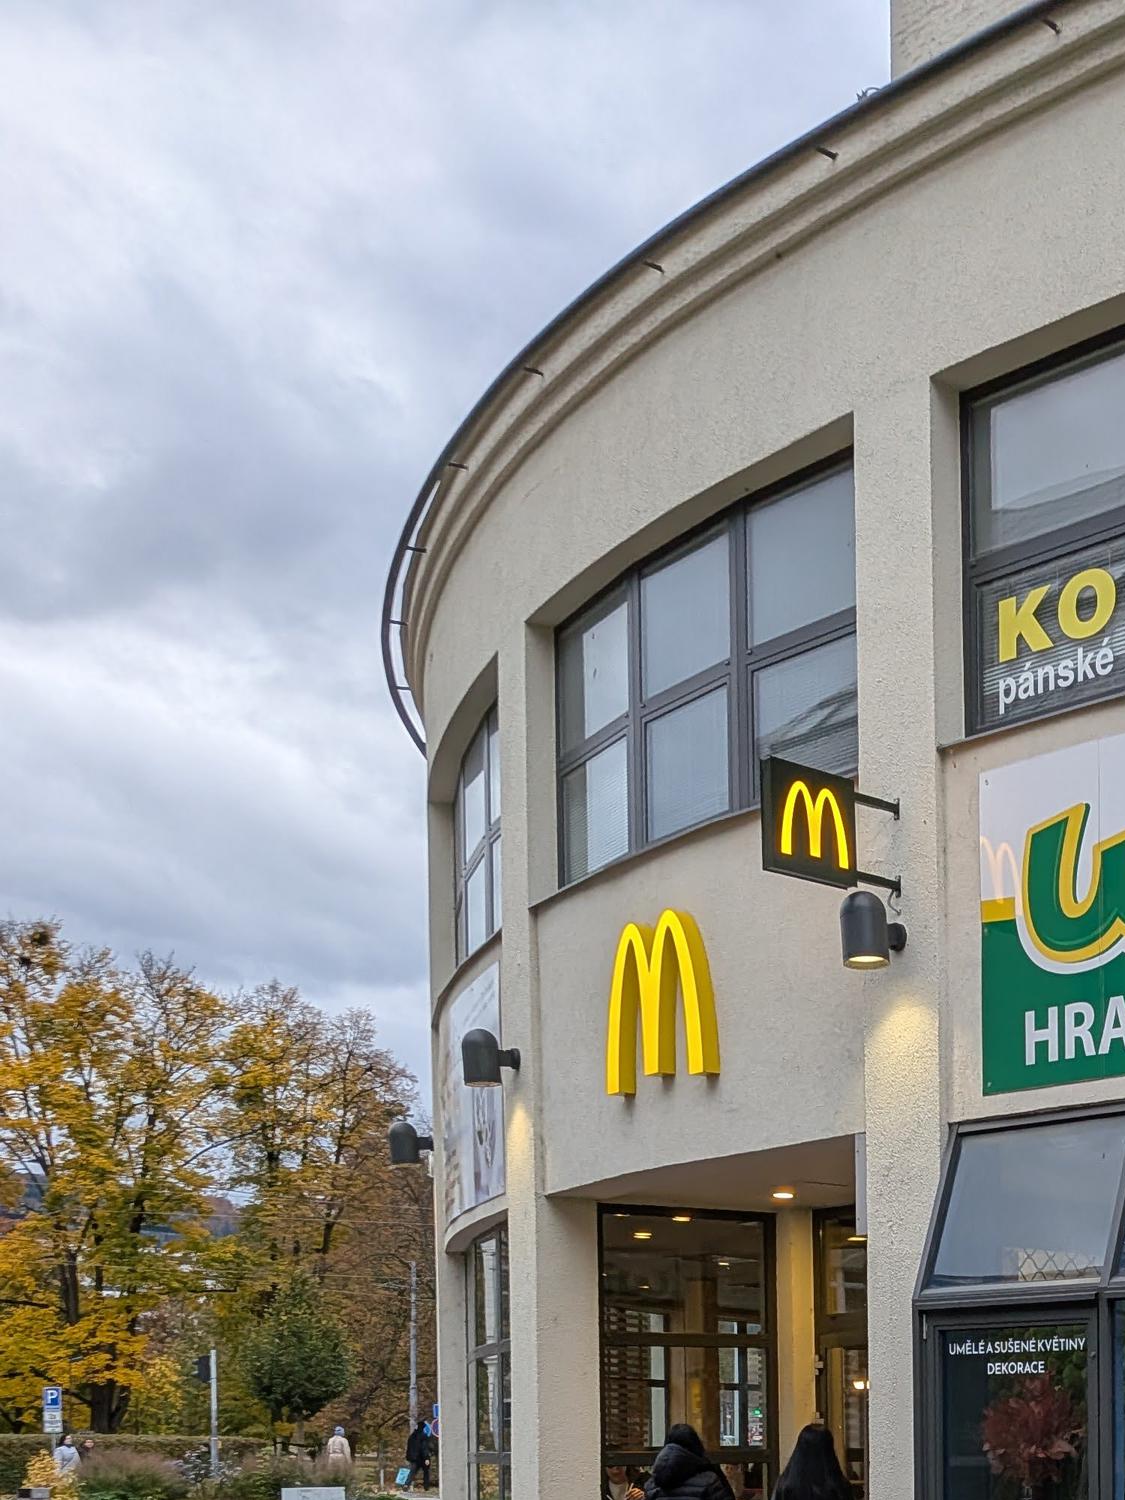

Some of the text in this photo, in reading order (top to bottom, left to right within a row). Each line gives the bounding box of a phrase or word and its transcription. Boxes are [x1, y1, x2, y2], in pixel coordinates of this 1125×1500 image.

[998, 567, 1117, 663] KO
[998, 638, 1116, 716] pánské
[948, 1335, 1086, 1355] UMĚLÉ A SUŠENÉ KVĚTINY
[987, 1360, 1045, 1375] DEKORACE
[46, 1390, 58, 1404] P
